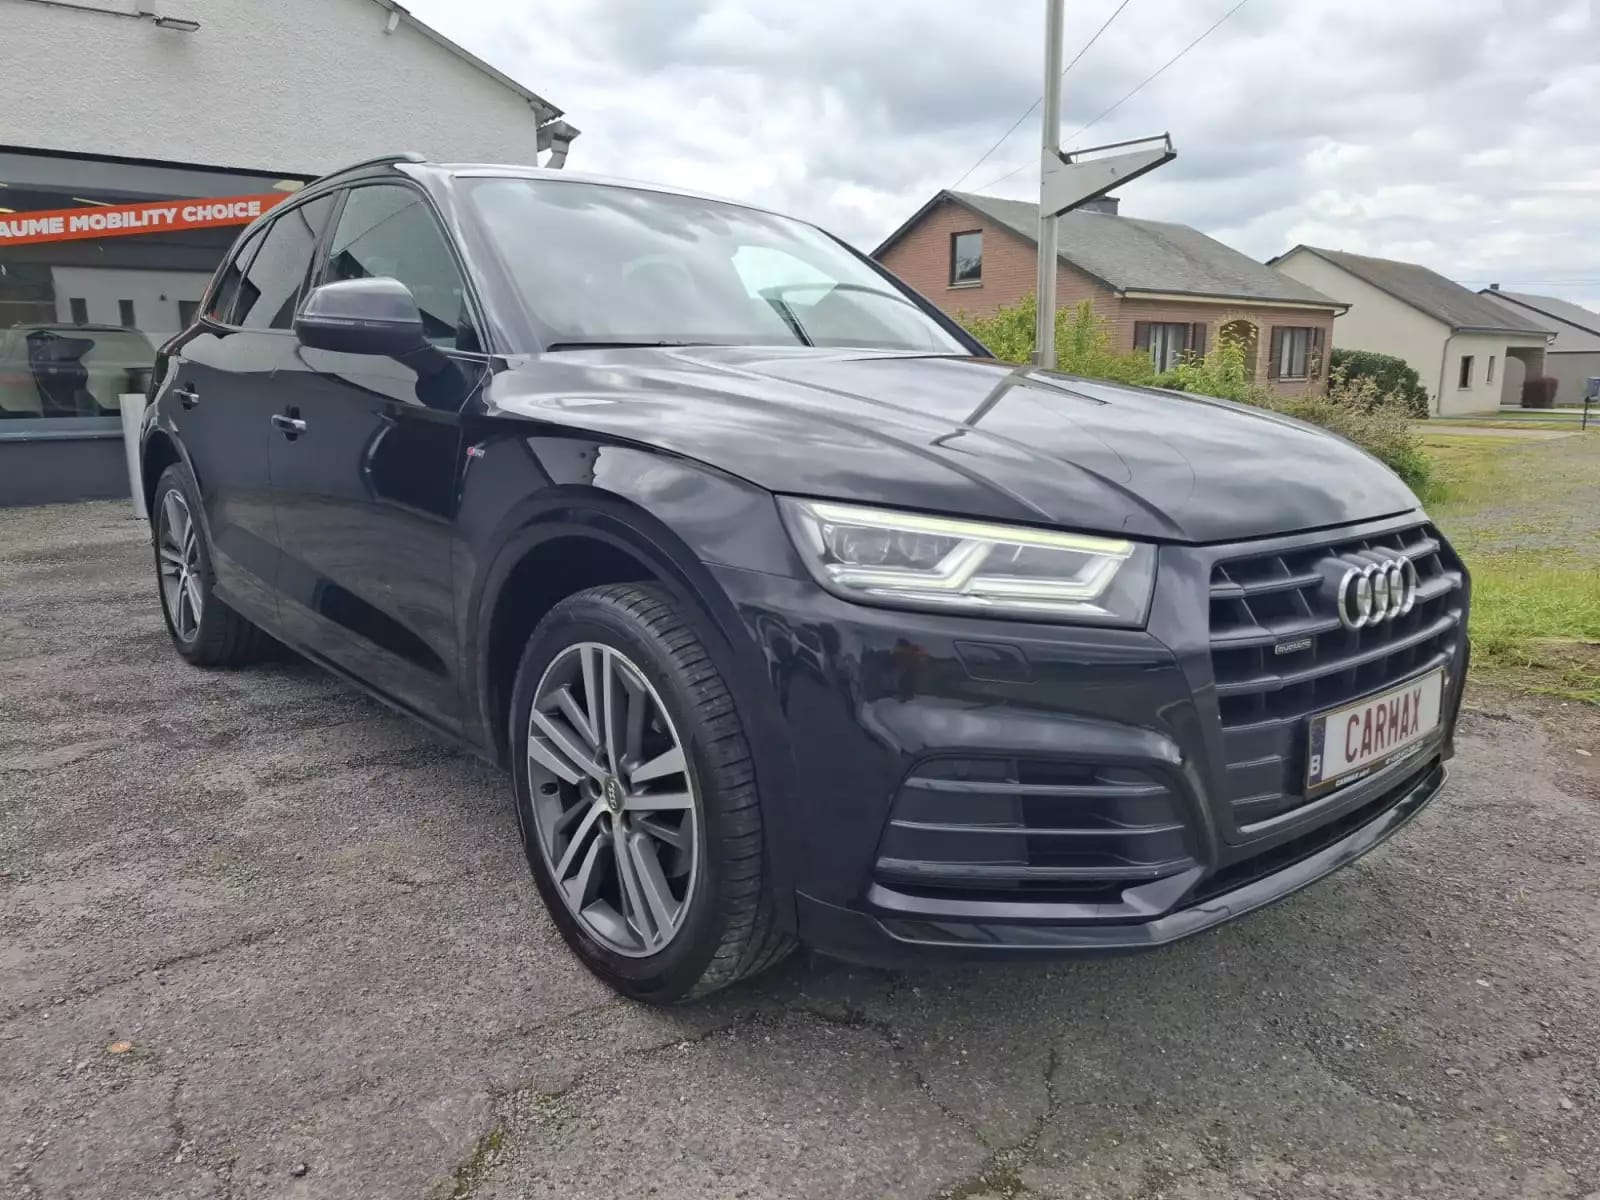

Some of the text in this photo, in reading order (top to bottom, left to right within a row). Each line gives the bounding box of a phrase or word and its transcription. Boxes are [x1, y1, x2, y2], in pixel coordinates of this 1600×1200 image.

[69, 207, 178, 233] MOBILITY
[182, 200, 261, 222] CHOICE
[1344, 687, 1422, 763] CARMAX
[1310, 754, 1322, 777] B
